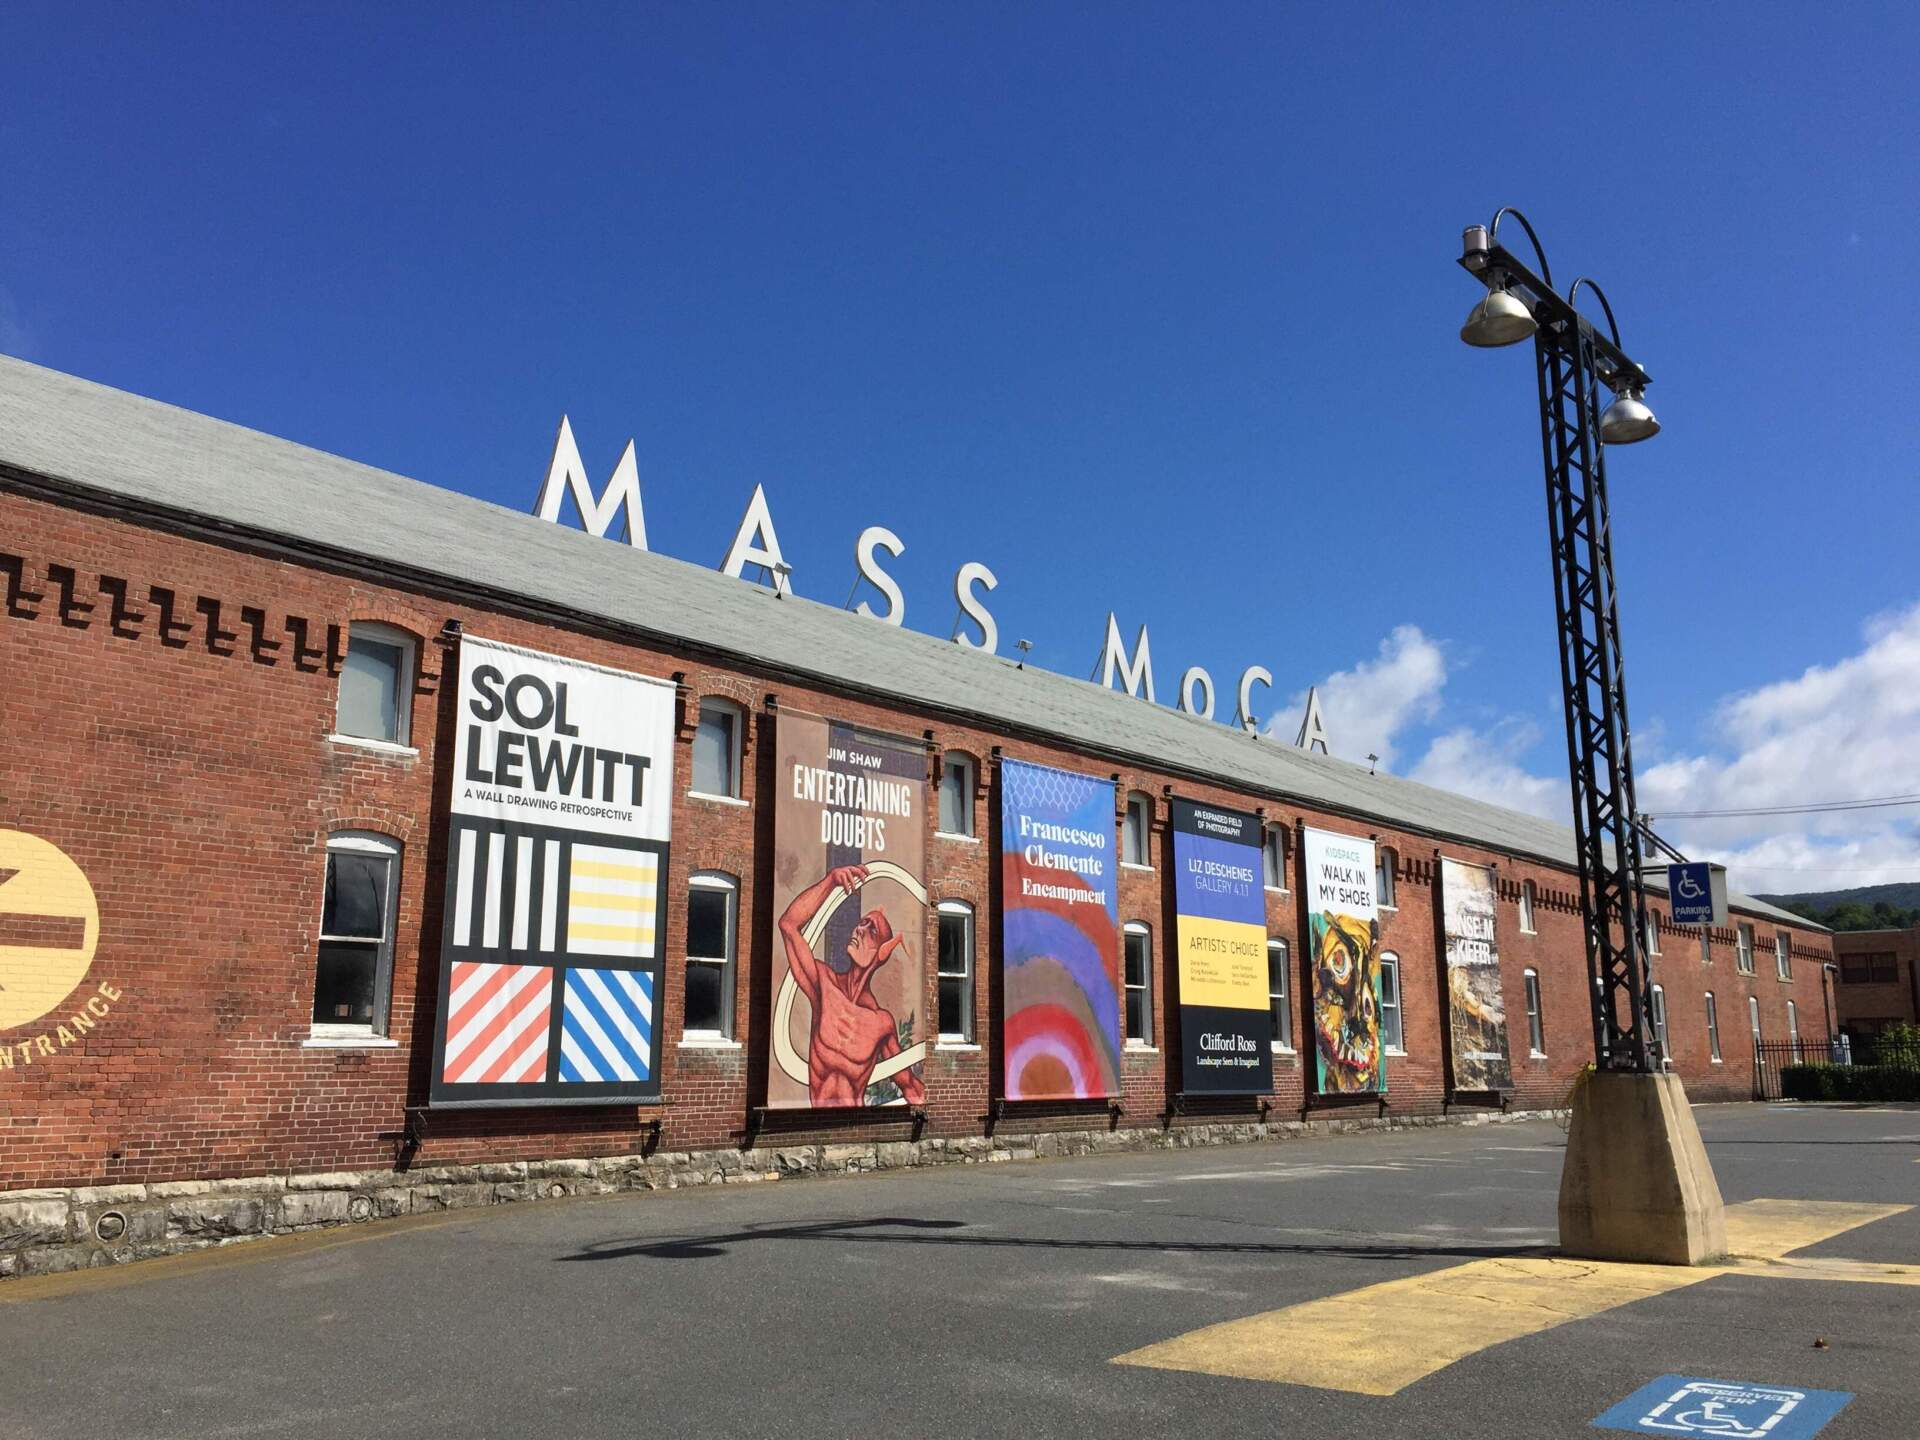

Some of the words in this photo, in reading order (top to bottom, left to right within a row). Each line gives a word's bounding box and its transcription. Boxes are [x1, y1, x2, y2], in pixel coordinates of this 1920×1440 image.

[531, 413, 998, 656] MASS
[469, 664, 579, 737] SOL
[465, 724, 651, 807] LEWITT
[826, 748, 846, 762] JIM
[849, 752, 882, 769] SHAW
[793, 764, 911, 818] ENTERTAINING
[464, 788, 473, 799] A
[476, 789, 505, 803] WALL
[507, 795, 558, 811] DRAWING
[560, 803, 633, 822] RETROSPECTIVE
[1194, 810, 1202, 818] AN
[1202, 811, 1228, 824] EXPANDED
[1228, 817, 1242, 827] FIELD
[1198, 821, 1204, 829] OF
[1206, 822, 1240, 836] PHOTOGRAPHY
[821, 809, 885, 852] DOUBTS
[1020, 815, 1105, 849] Francesco
[1025, 844, 1103, 876] Clemente
[1325, 846, 1361, 862] KIDSPACE
[1189, 858, 1203, 873] LIZ
[1204, 862, 1253, 882] DESCHENES
[1321, 864, 1353, 883] WALK
[1355, 869, 1366, 886] IN
[1022, 877, 1106, 905] Encampment
[1195, 875, 1232, 894] GALLERY
[1320, 885, 1335, 901] MY
[1339, 888, 1370, 907] SHOES
[1675, 906, 1710, 915] PARKING
[1454, 912, 1494, 941] NSELM
[1230, 941, 1259, 957] CHOICE
[1200, 1033, 1235, 1051] Clifford
[1237, 1036, 1256, 1052] Ross
[1196, 1055, 1222, 1069] Landscape
[1222, 1057, 1234, 1067] Seen
